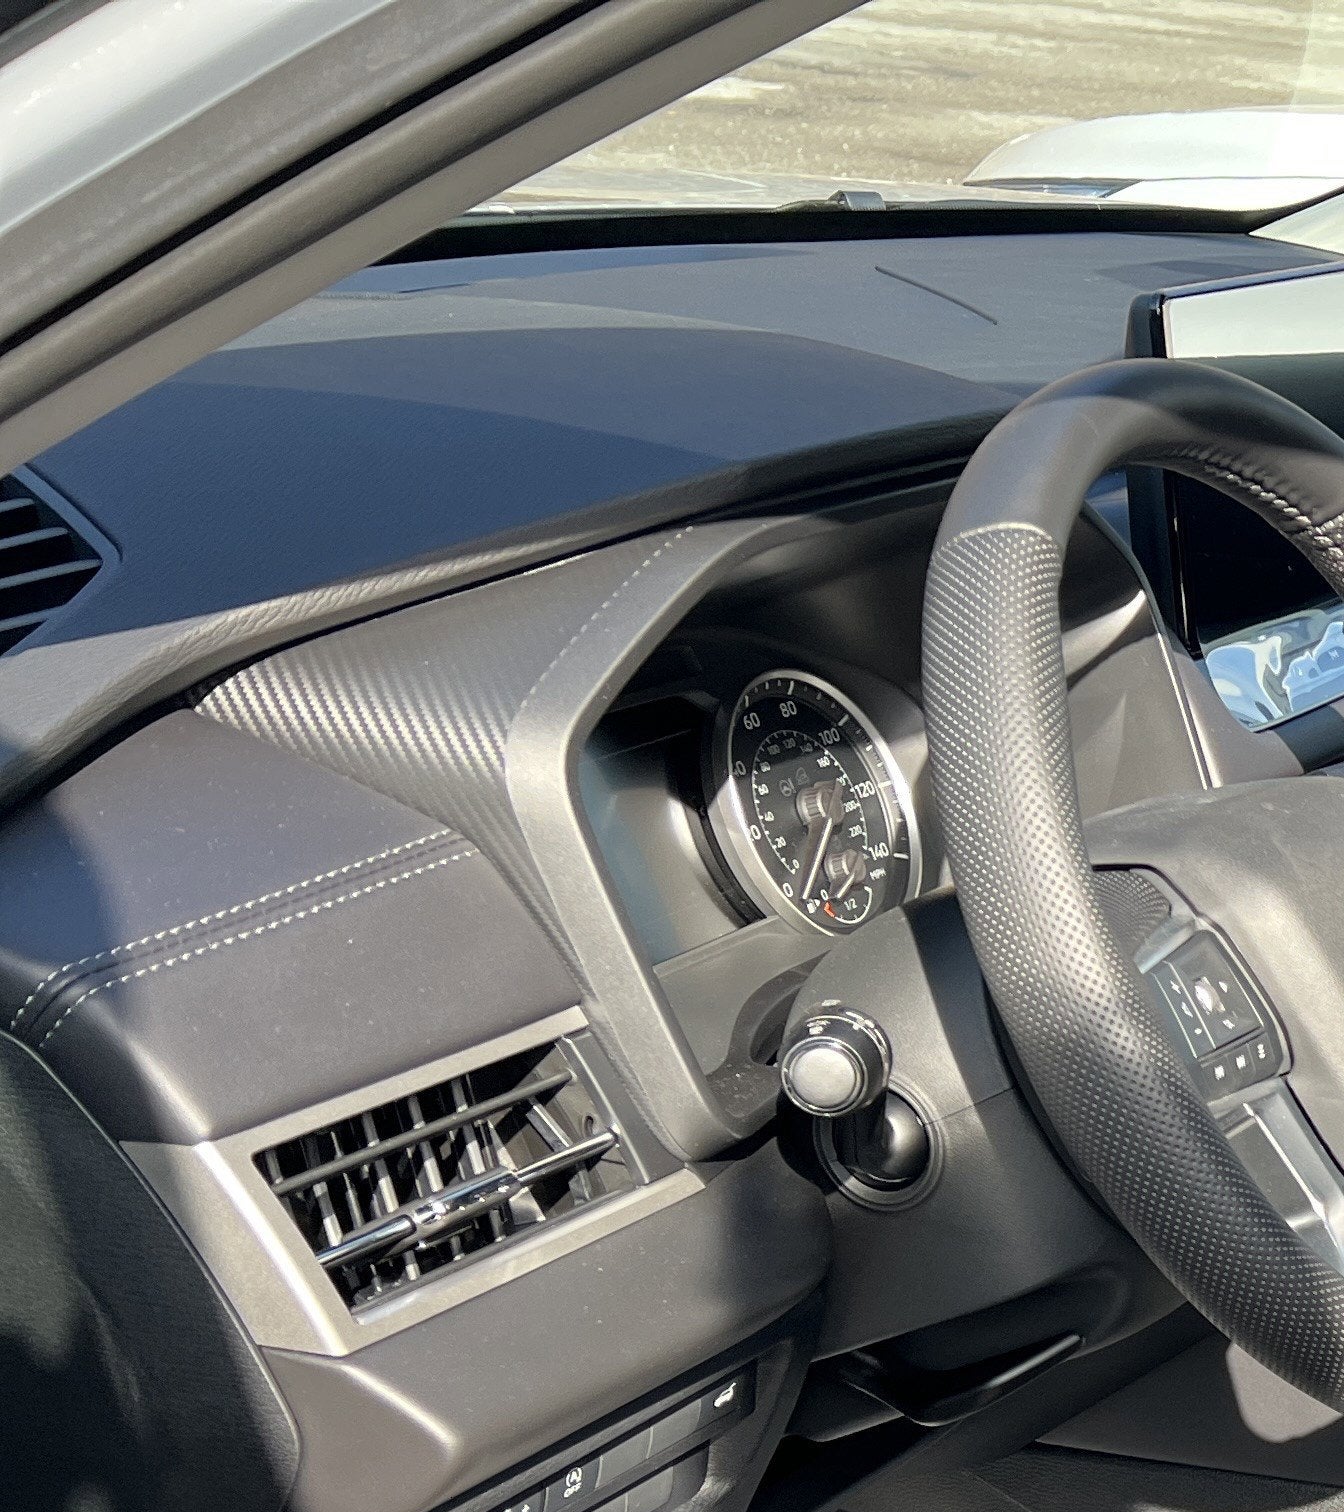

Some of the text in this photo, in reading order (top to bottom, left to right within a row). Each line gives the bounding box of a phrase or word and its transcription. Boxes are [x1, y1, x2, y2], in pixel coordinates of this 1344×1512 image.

[779, 701, 797, 718] 80
[743, 712, 761, 730] 60
[818, 728, 840, 746] 100
[855, 781, 876, 798] 120
[868, 842, 889, 861] 140
[869, 868, 887, 881] MPH
[782, 883, 794, 898] 0
[820, 889, 829, 901] 0
[844, 898, 858, 911] 1/2
